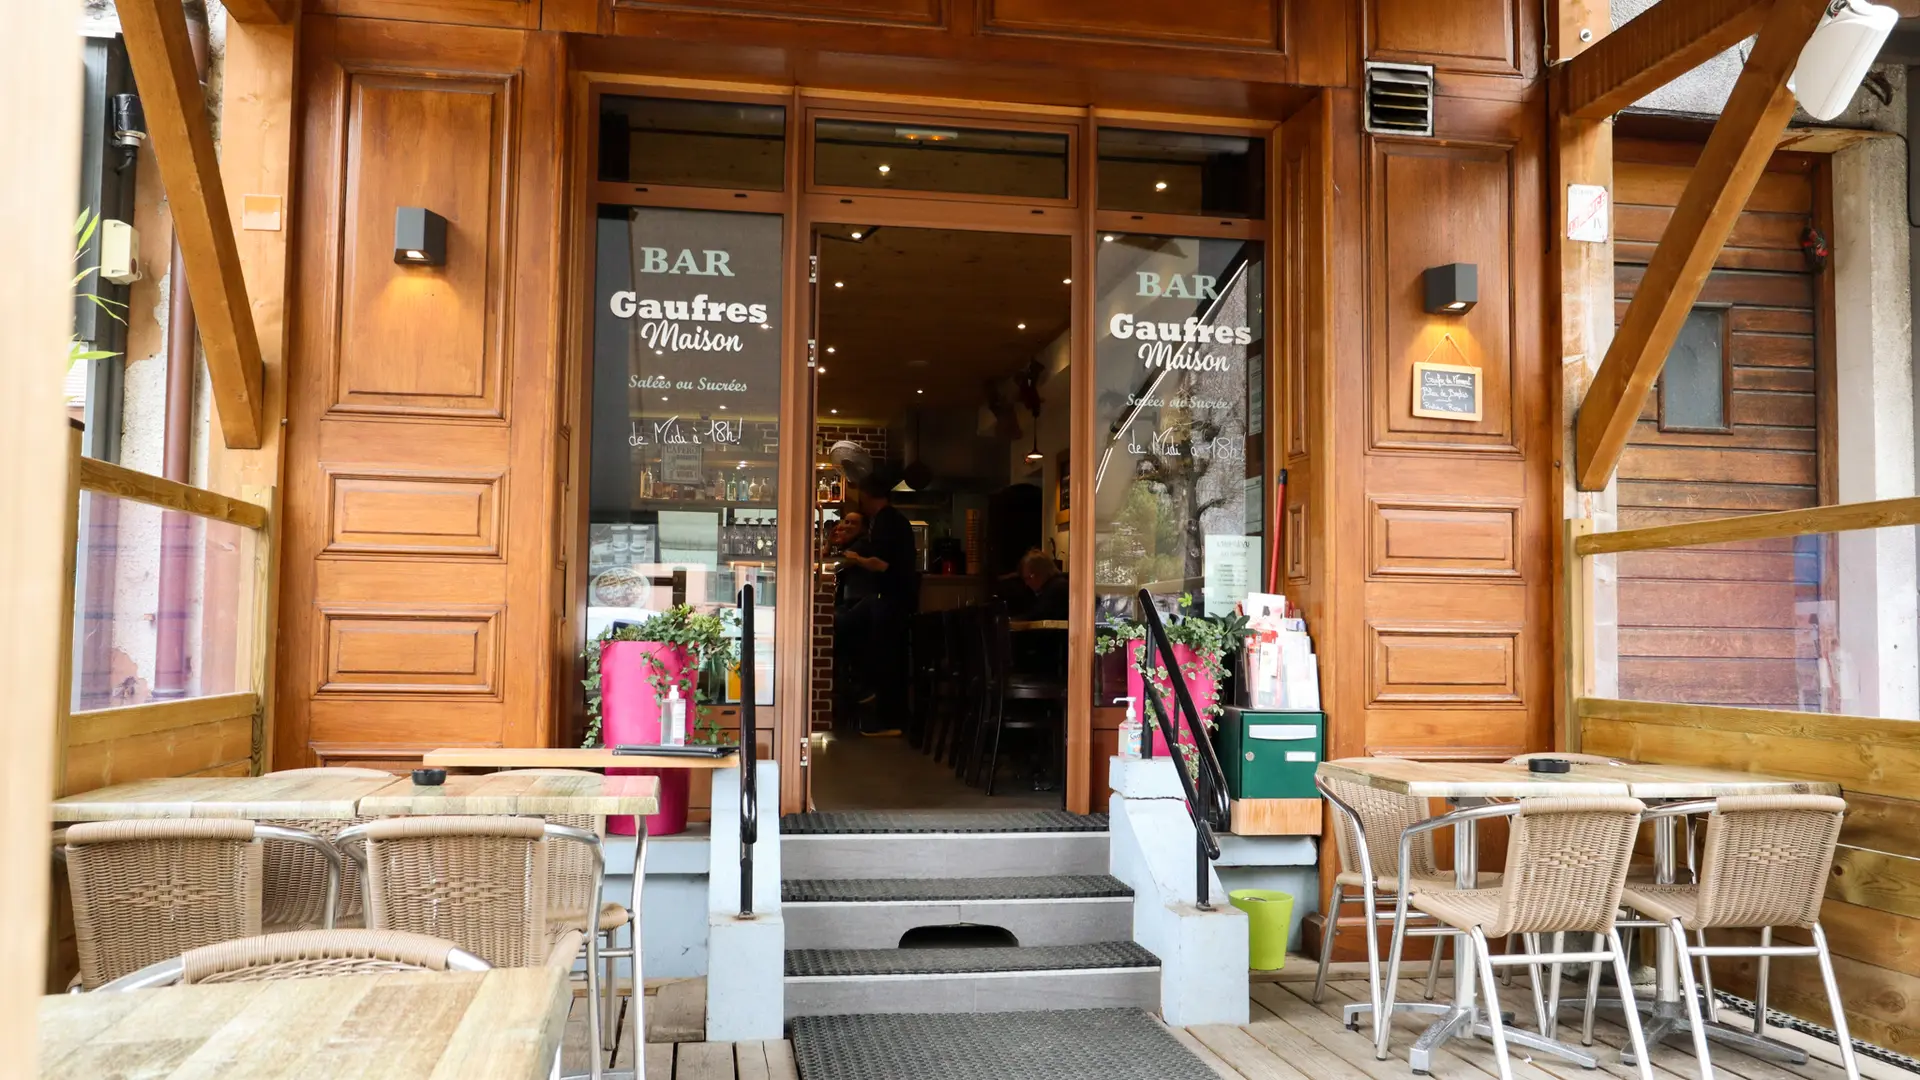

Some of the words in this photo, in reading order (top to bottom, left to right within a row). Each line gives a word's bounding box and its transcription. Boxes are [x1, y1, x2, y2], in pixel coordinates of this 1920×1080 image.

[640, 246, 735, 277] BAR
[1136, 271, 1221, 300] BAR
[610, 290, 768, 324] Gaufres
[640, 320, 743, 352] Maison
[1110, 313, 1252, 345] Gaufres
[1138, 341, 1231, 372] Maison
[628, 374, 671, 390] Salées
[676, 381, 693, 391] ou
[697, 377, 747, 392] Sucrées
[1126, 393, 1165, 407] Salées
[1169, 397, 1187, 408] ou
[1188, 396, 1233, 409] Sucrées
[628, 422, 648, 446] de
[654, 415, 687, 445] Midi
[692, 427, 702, 445] à
[704, 418, 743, 446] 18h!
[1128, 429, 1146, 455] de
[1152, 426, 1181, 456] Midi
[1190, 437, 1199, 458] à
[1206, 433, 1246, 461] 18h!
